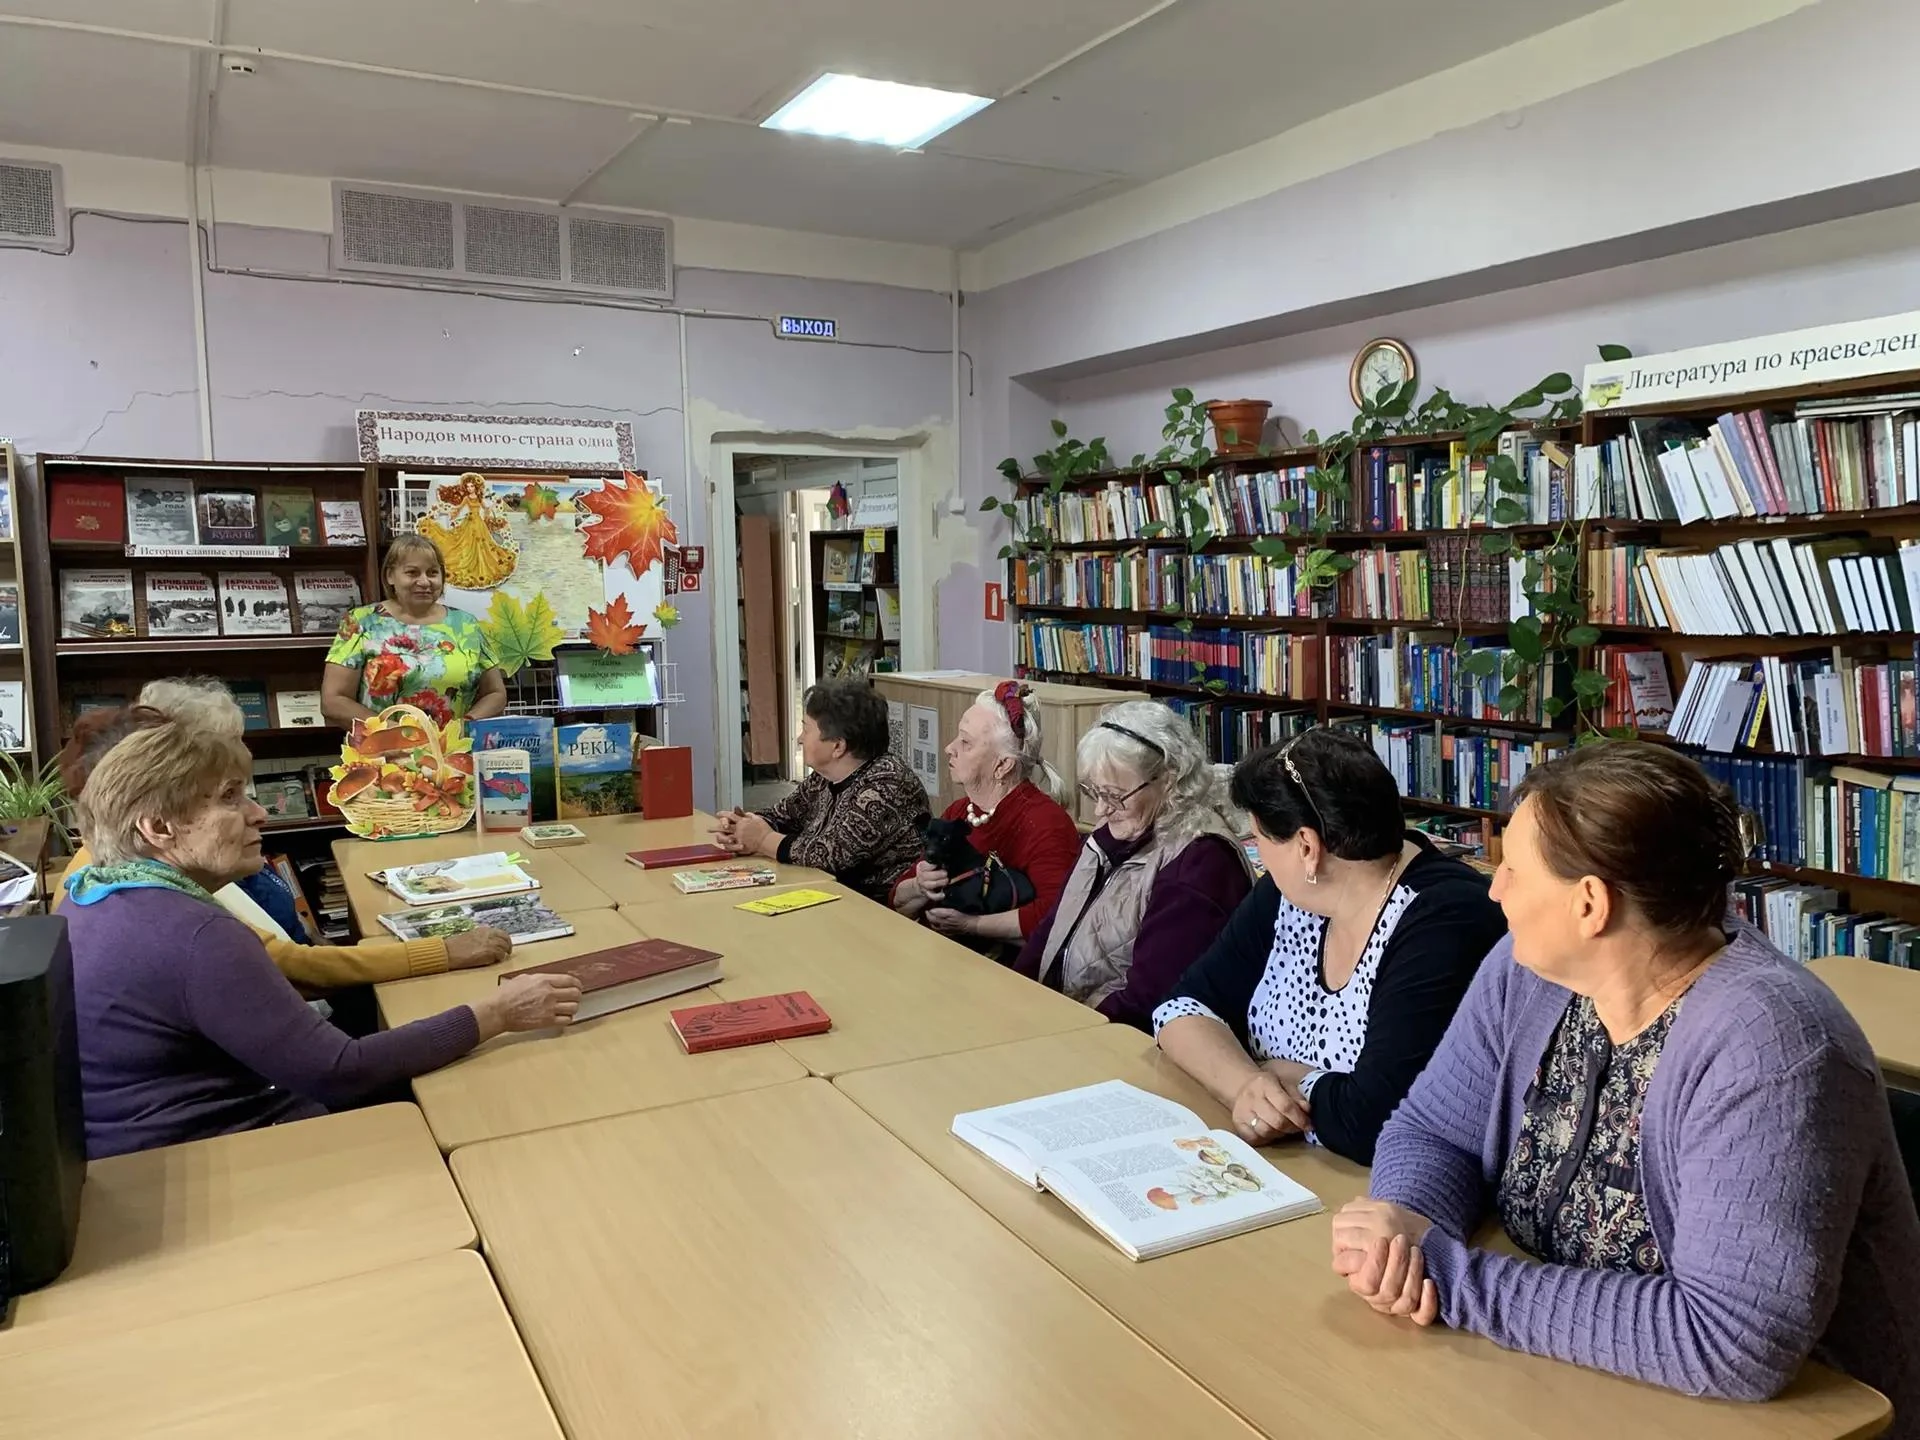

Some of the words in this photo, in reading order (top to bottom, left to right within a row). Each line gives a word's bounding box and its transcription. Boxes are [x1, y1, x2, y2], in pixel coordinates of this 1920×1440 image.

[782, 318, 834, 337] ВЫХОД
[1625, 358, 1747, 391] Литература
[1754, 352, 1782, 371] по
[1790, 333, 1920, 370] краеведен
[380, 427, 456, 444] Народов
[460, 431, 575, 449] много-страна
[578, 436, 614, 449] одна
[140, 546, 184, 557] Истории
[186, 547, 227, 556] славные
[229, 547, 275, 558] страницы
[568, 740, 617, 756] РЕКИ
